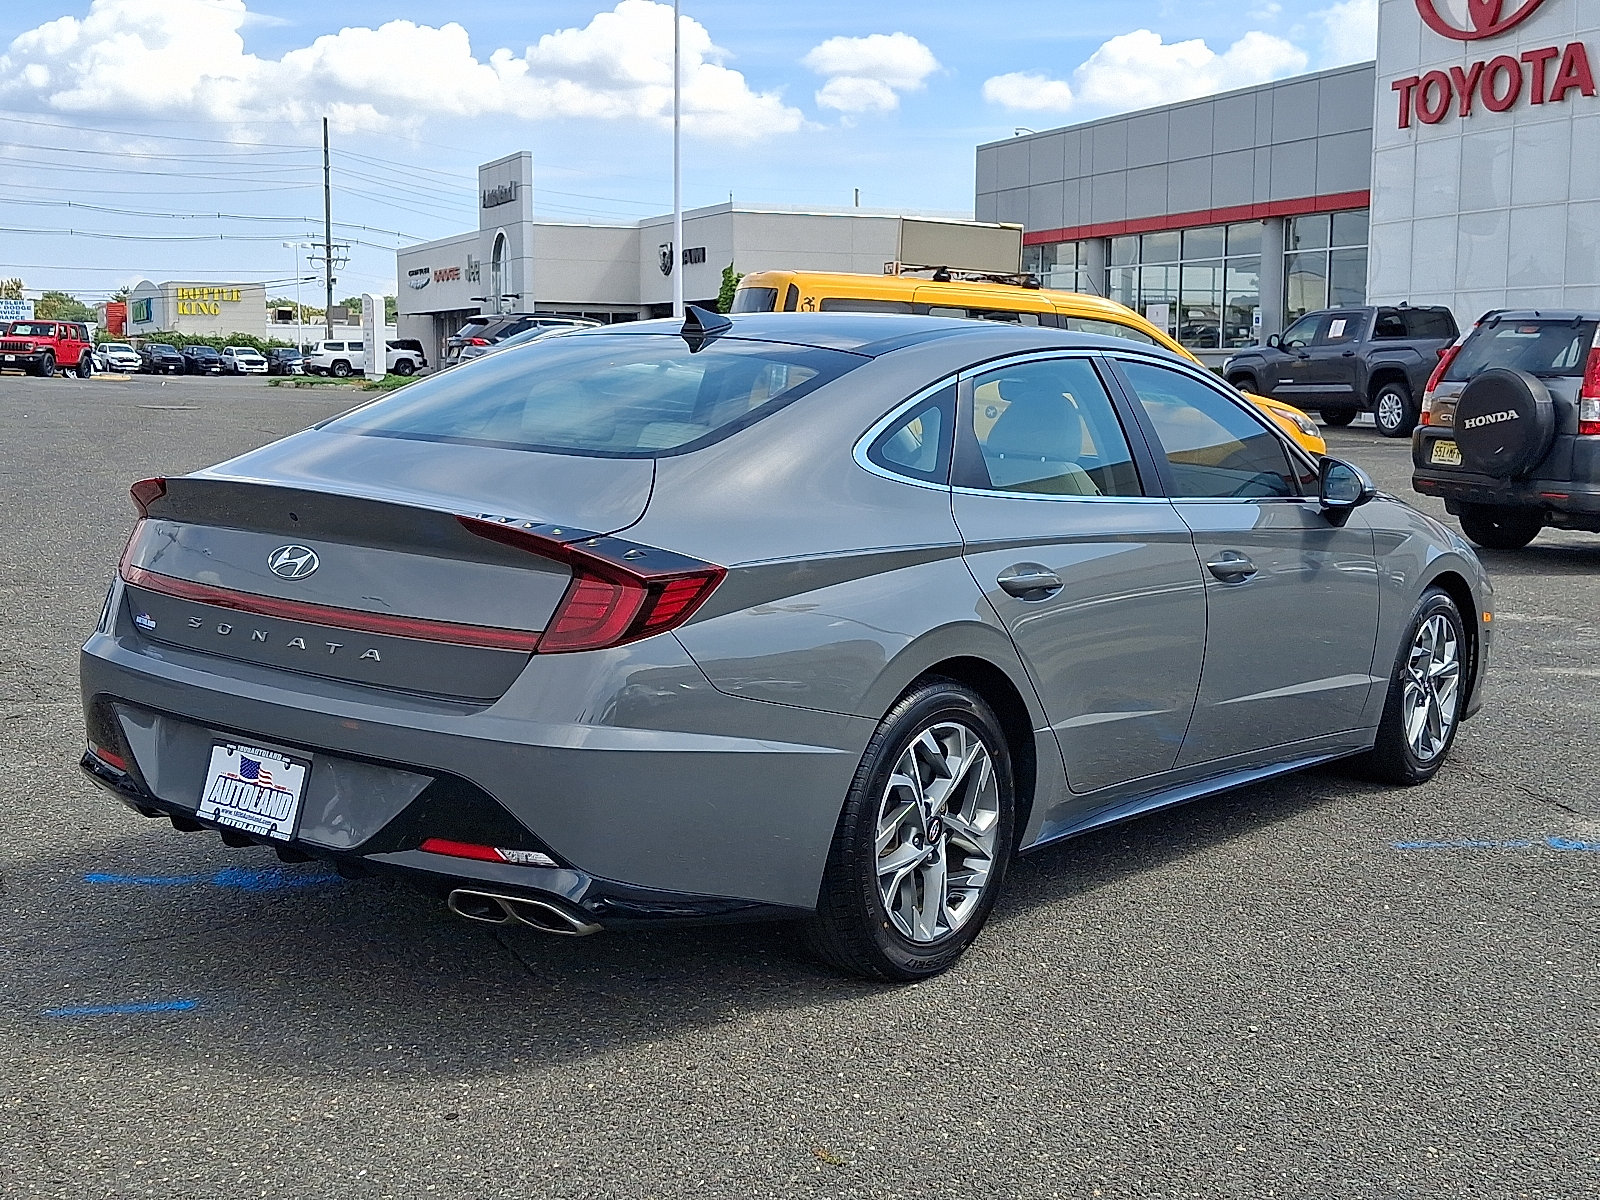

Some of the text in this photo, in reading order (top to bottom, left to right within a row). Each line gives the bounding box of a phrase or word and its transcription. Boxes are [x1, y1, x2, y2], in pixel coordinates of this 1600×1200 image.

[1391, 41, 1596, 129] TOYOTA
[177, 287, 242, 301] BOTTLE
[178, 302, 220, 315] KING
[1464, 409, 1520, 429] HONDA
[187, 616, 382, 662] SONATA
[207, 775, 294, 822] AUTOLAND
[216, 816, 269, 835] AUTOLAND
